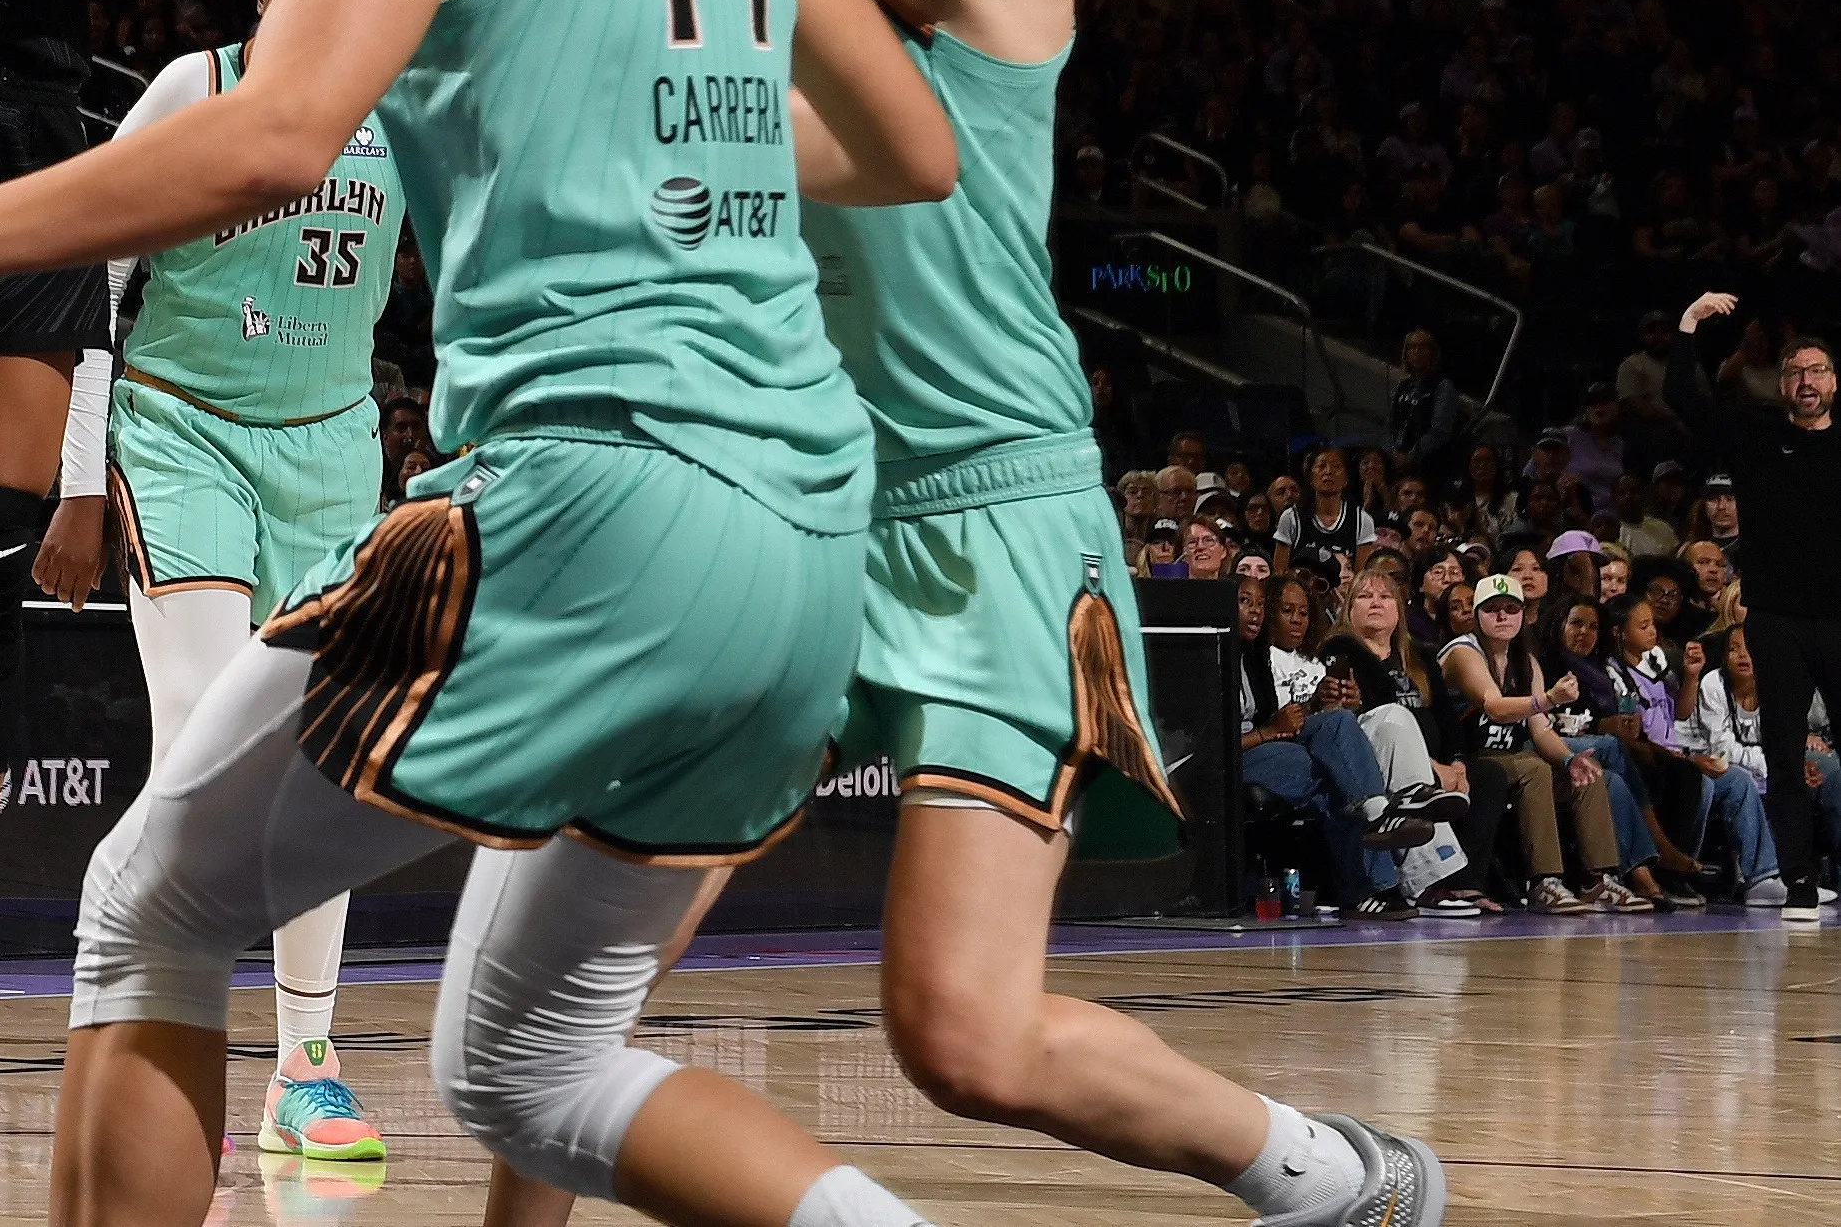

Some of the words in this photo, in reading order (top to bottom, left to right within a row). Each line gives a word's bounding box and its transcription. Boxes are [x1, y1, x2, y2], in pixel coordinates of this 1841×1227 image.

[652, 75, 784, 146] CARRERA
[343, 146, 386, 157] BARCLAYS
[715, 190, 786, 239] AT&T
[294, 226, 367, 289] 35
[277, 331, 328, 347] Mutual
[278, 315, 328, 332] Liberty
[17, 757, 111, 807] AT&T
